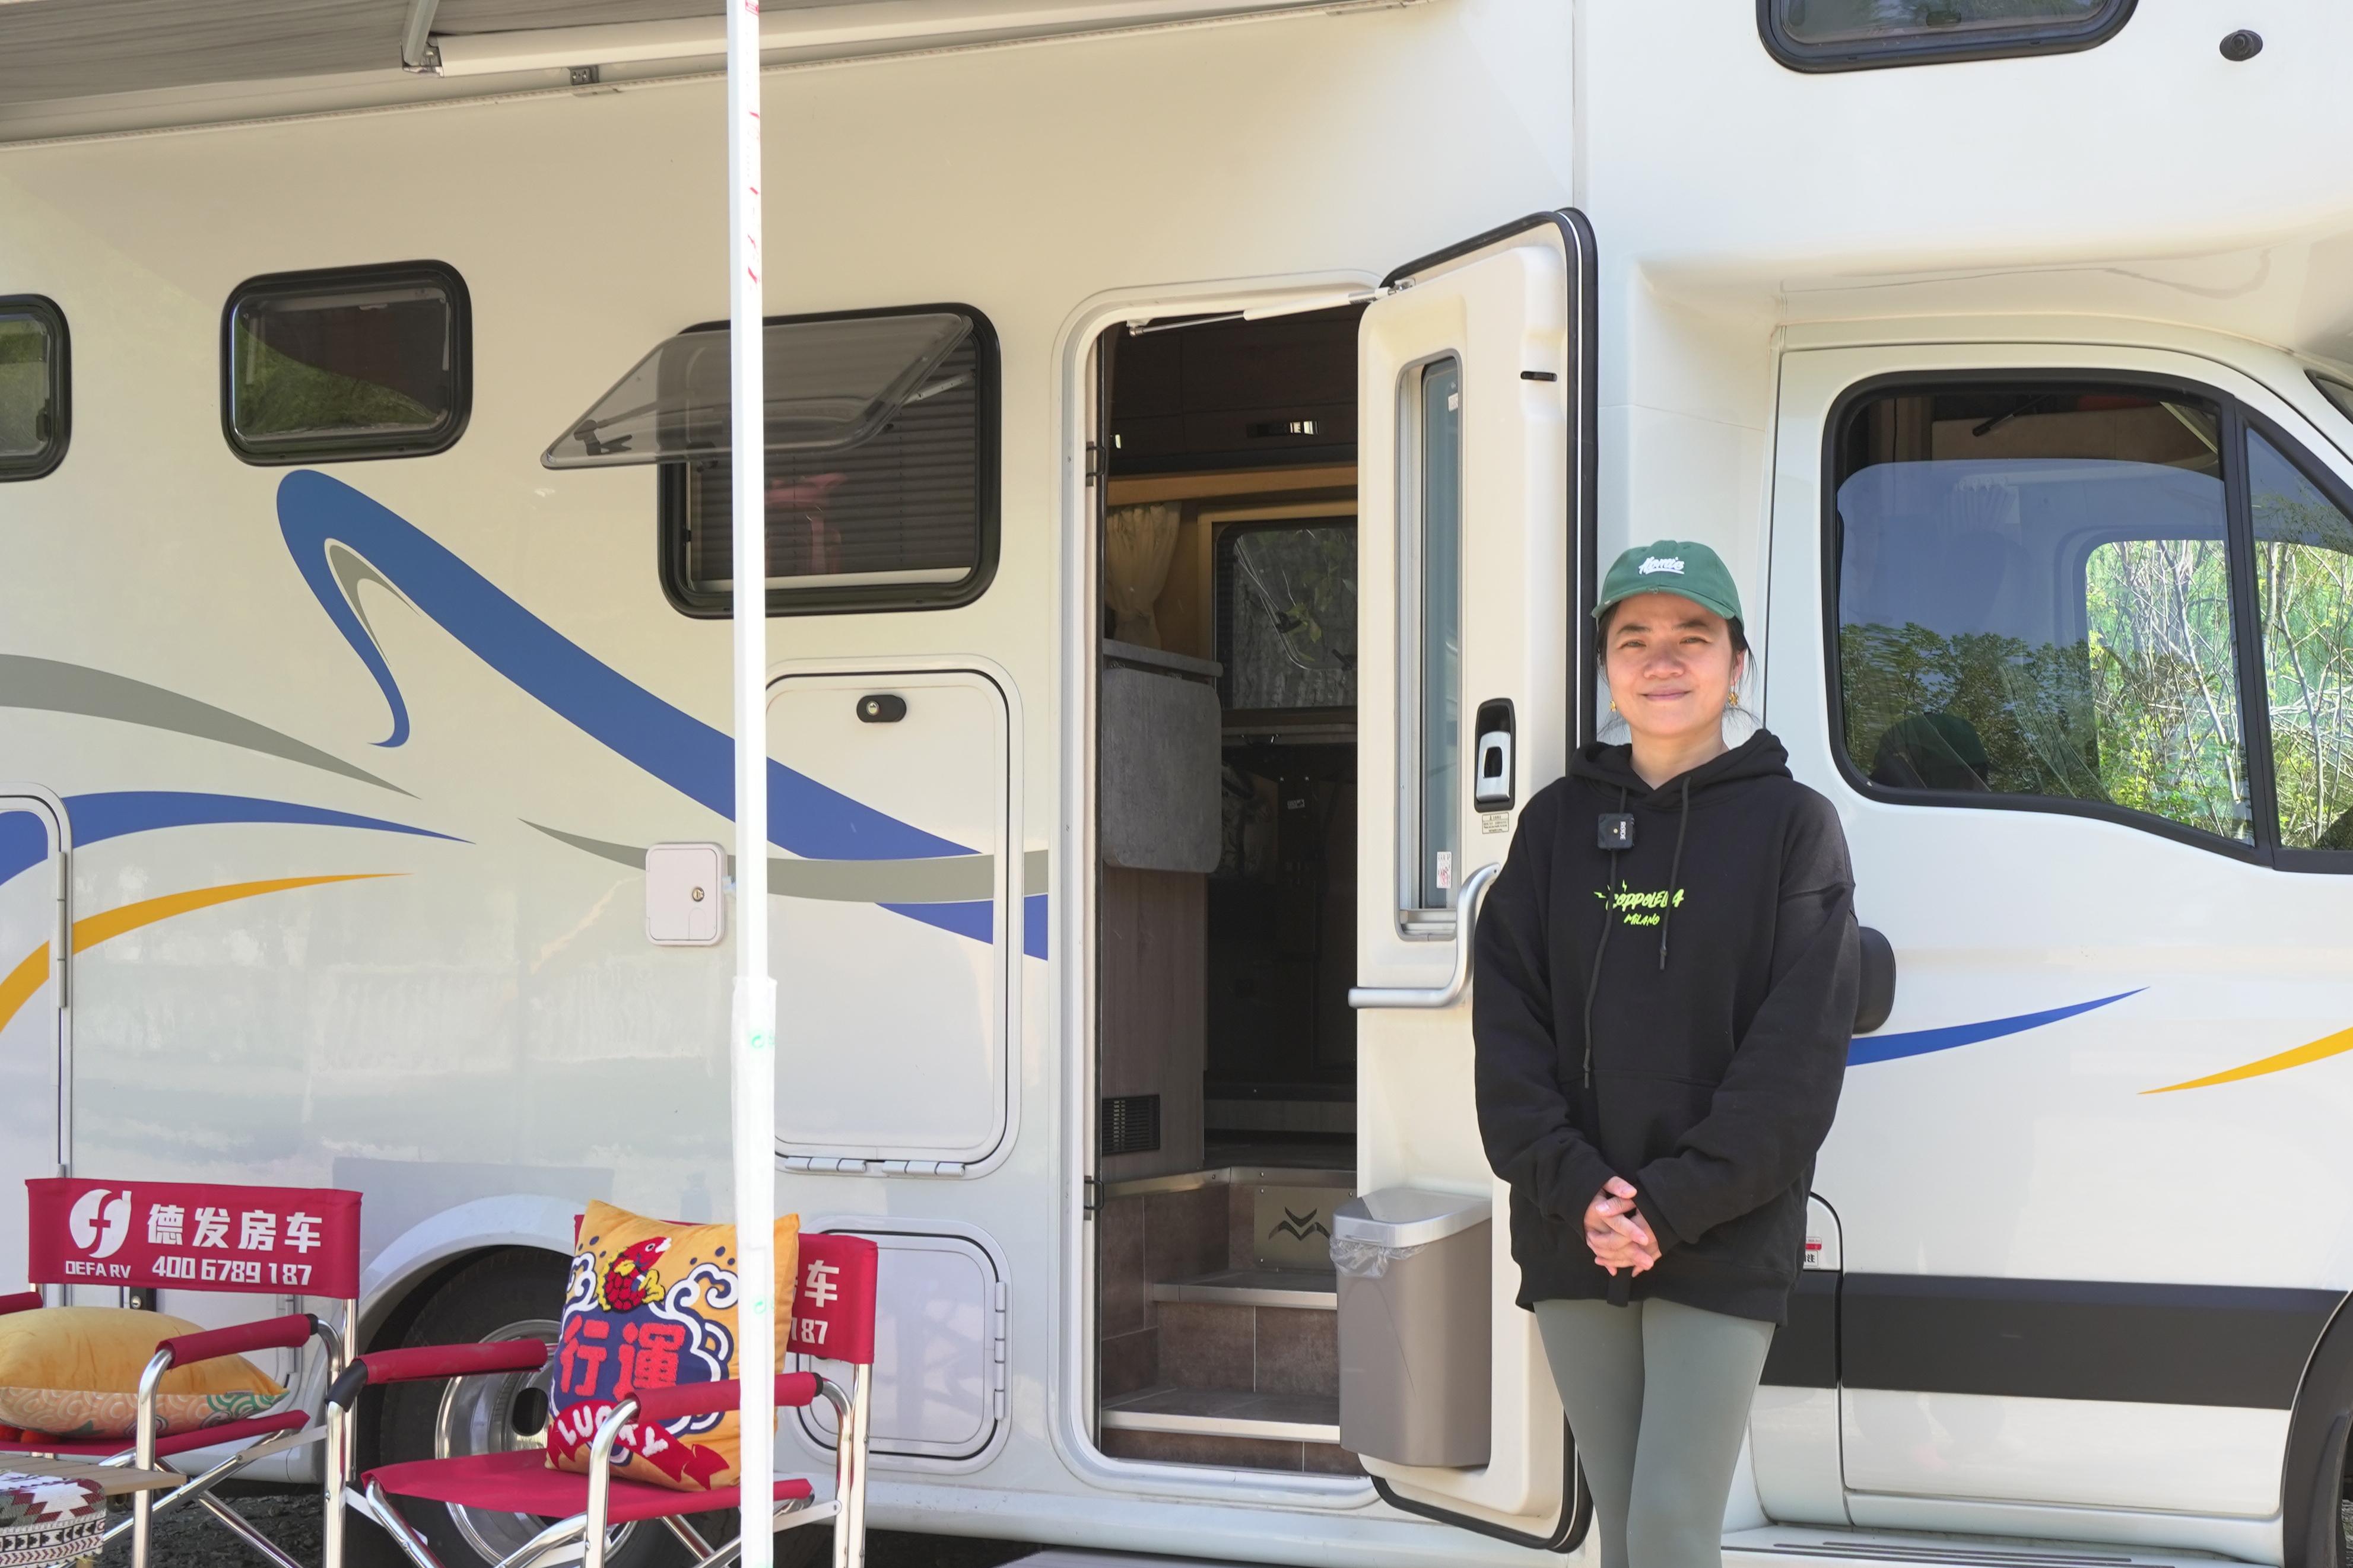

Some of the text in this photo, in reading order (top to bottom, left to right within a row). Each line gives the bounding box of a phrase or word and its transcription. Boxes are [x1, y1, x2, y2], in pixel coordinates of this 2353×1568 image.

[147, 1204, 322, 1253] 德发房车
[66, 1260, 131, 1278] DEFA RV
[152, 1256, 312, 1286] 400 6789 187
[793, 1260, 839, 1308] 车
[791, 1317, 828, 1344] 187
[560, 1315, 685, 1401] 行運
